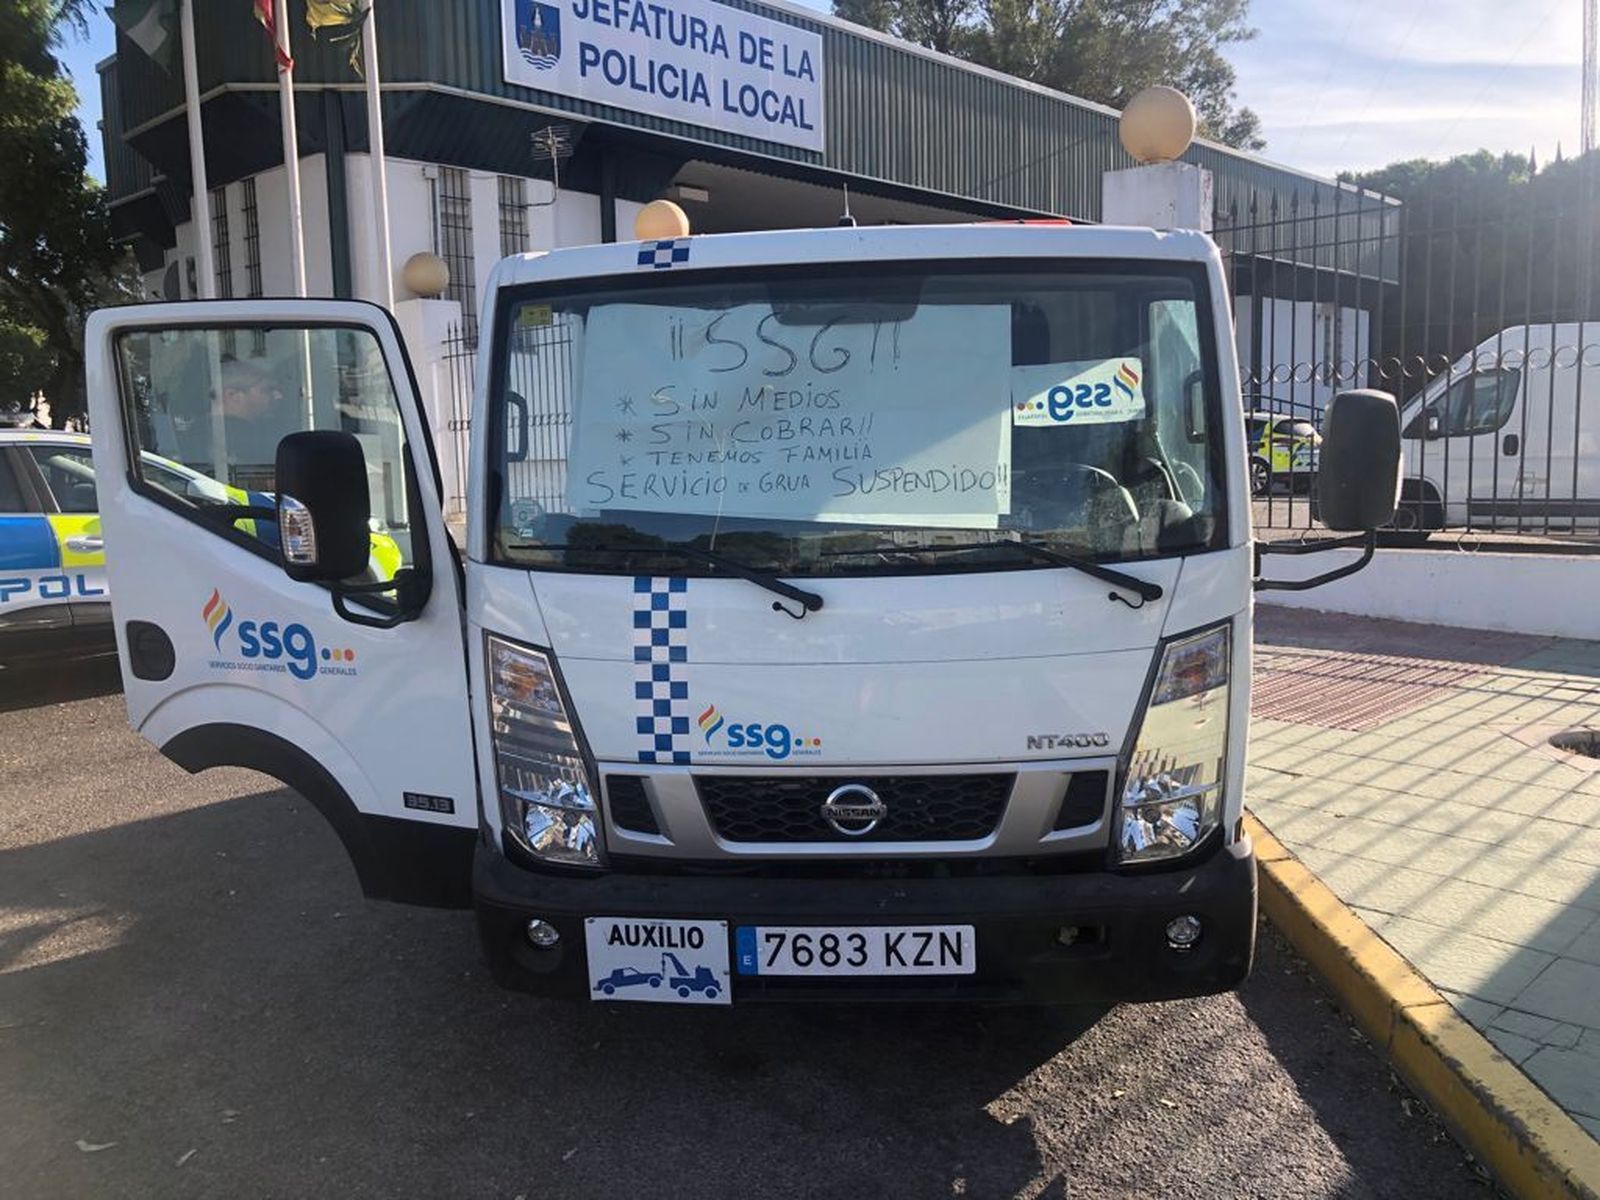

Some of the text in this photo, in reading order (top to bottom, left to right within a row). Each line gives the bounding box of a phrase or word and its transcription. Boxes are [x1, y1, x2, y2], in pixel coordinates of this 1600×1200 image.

[572, 0, 815, 82] JEFATURA DE LA
[579, 42, 814, 130] POLICIA LOCAL
[646, 450, 762, 467] TENEMOS
[759, 472, 810, 493] GRUA
[318, 666, 357, 676] GENERALES
[1026, 732, 1109, 750] NT400
[826, 806, 880, 818] NISSAN
[608, 924, 704, 949] AUXILIO
[764, 932, 868, 968] 7683
[884, 931, 963, 968] KZN
